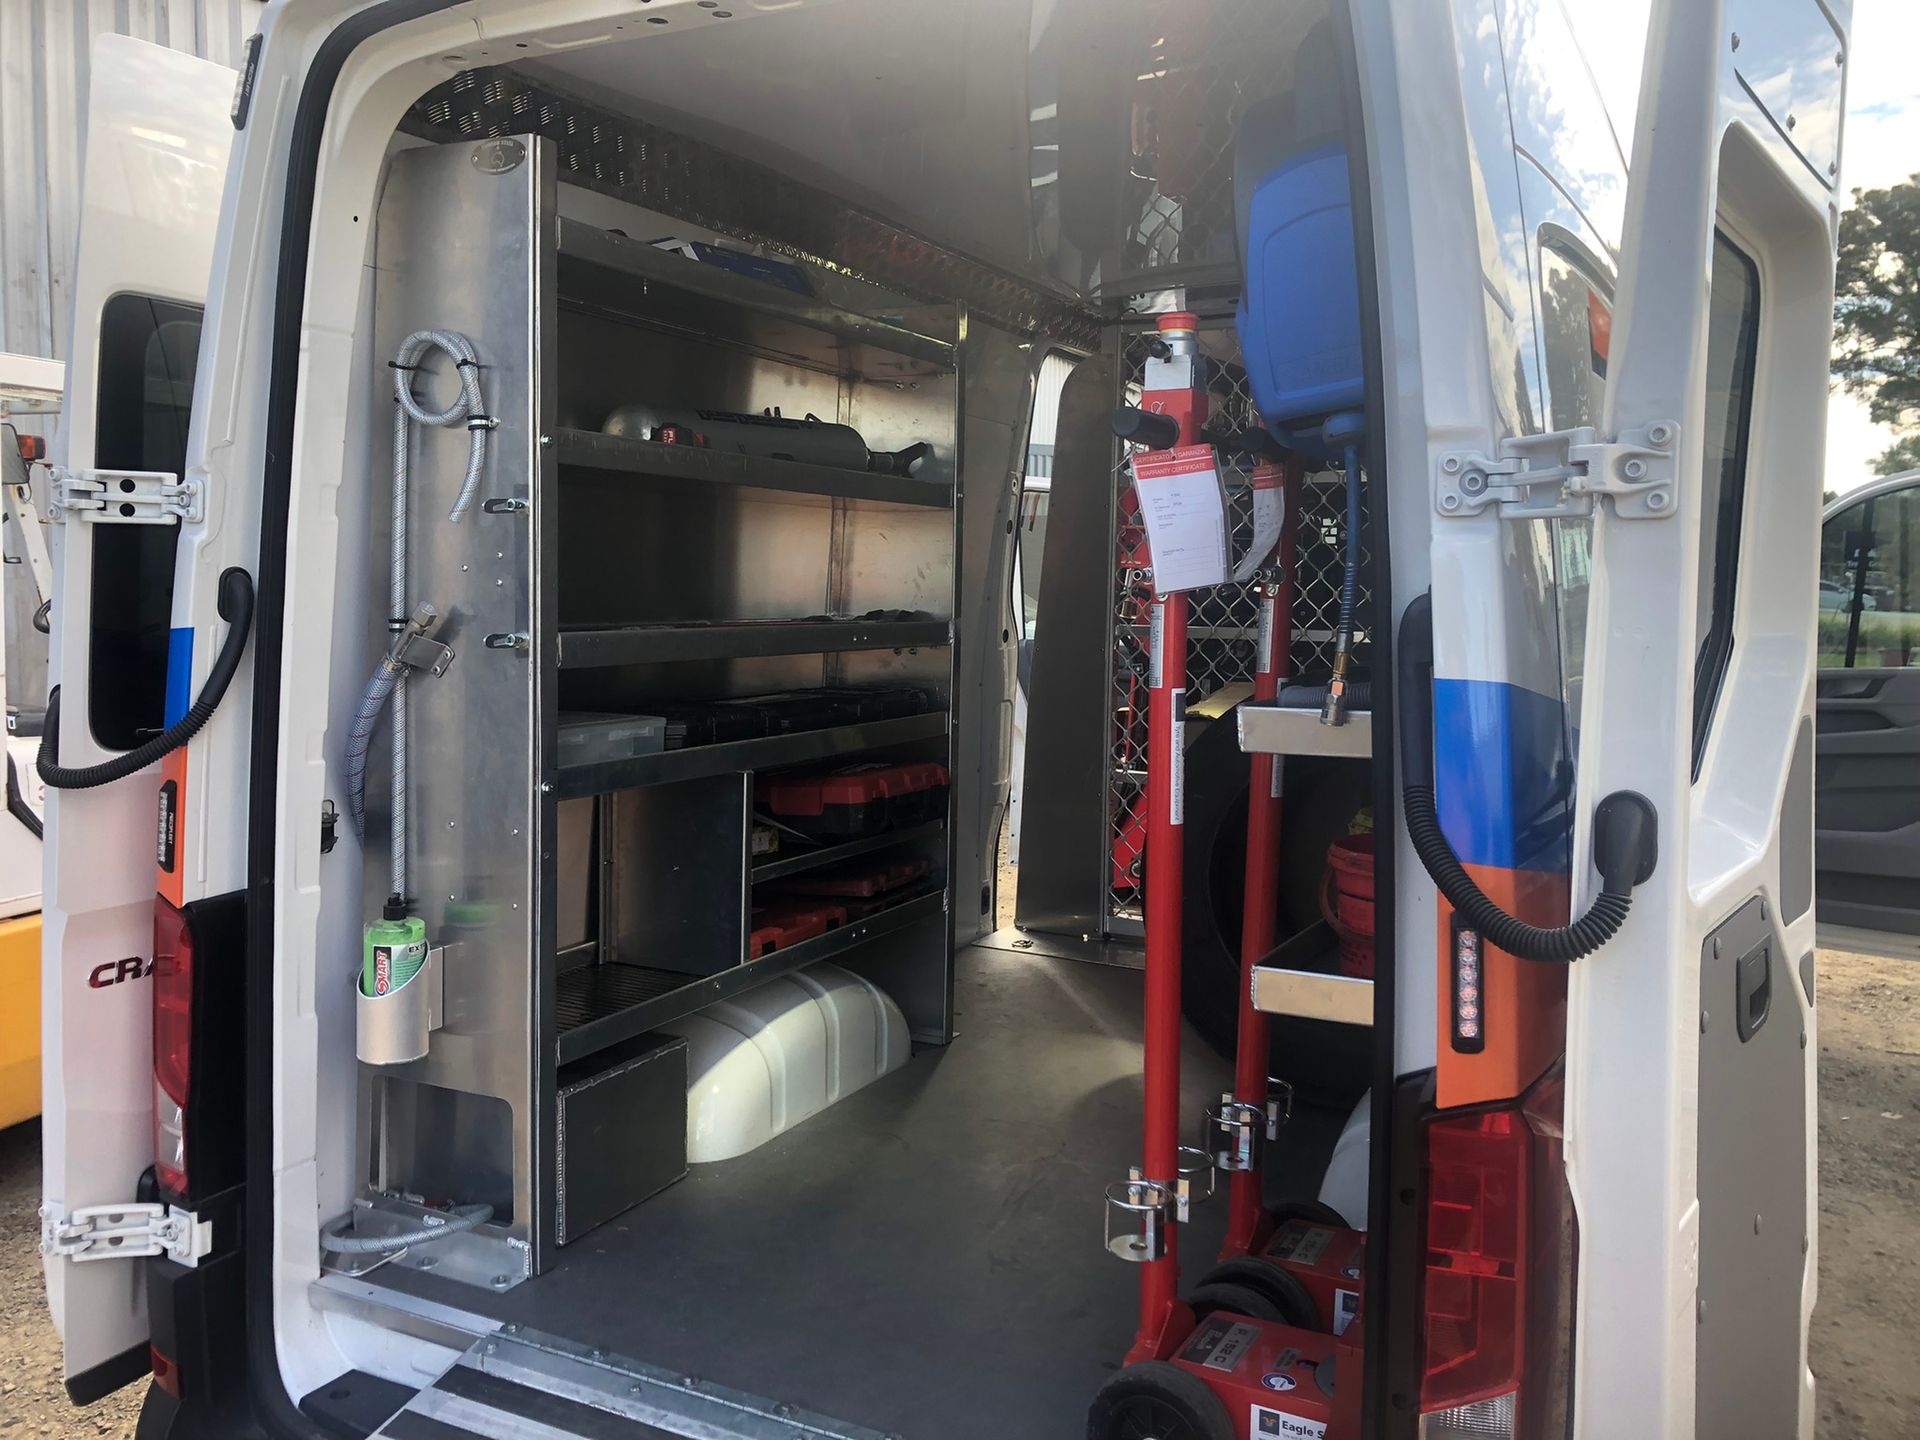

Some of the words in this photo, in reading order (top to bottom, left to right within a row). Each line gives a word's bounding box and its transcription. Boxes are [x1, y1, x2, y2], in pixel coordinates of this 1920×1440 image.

[1171, 462, 1206, 473] CERTIFICATE
[375, 950, 390, 996] SMART
[1219, 1339, 1240, 1355] 152
[1214, 1355, 1226, 1363] C
[1282, 1420, 1314, 1437] Eagle
